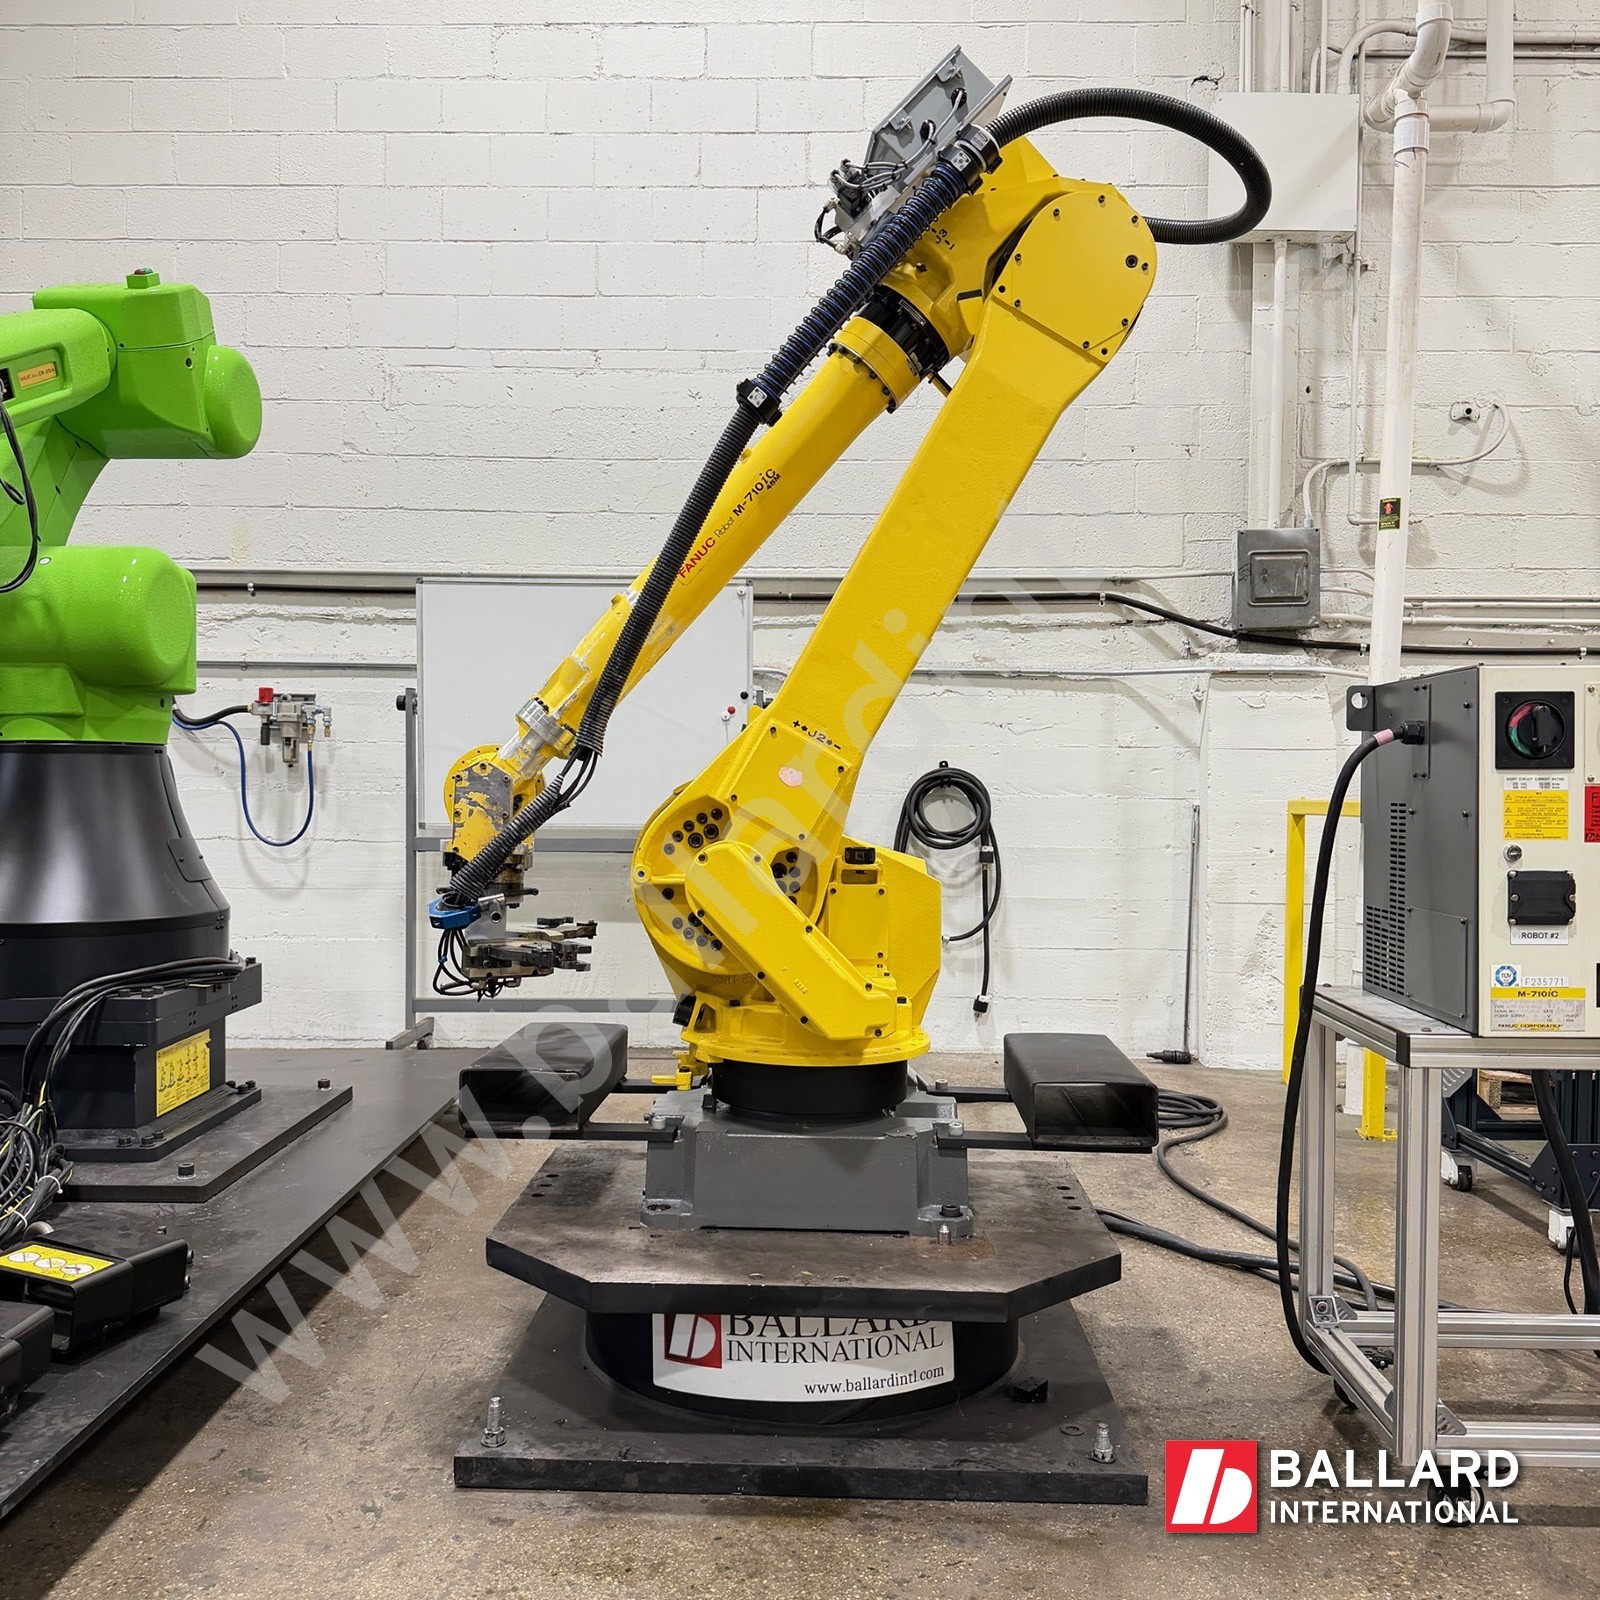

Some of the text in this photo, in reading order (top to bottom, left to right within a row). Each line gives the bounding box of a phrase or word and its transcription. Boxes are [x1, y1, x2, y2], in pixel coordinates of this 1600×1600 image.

[766, 473, 781, 490] 45M
[679, 468, 776, 578] FANUC Robot M-710iC
[1517, 988, 1558, 998] M-710iC
[1525, 977, 1564, 986] F235771
[726, 1326, 944, 1364] INTERNATIONAL
[804, 1366, 945, 1395] www.ballardintl.com
